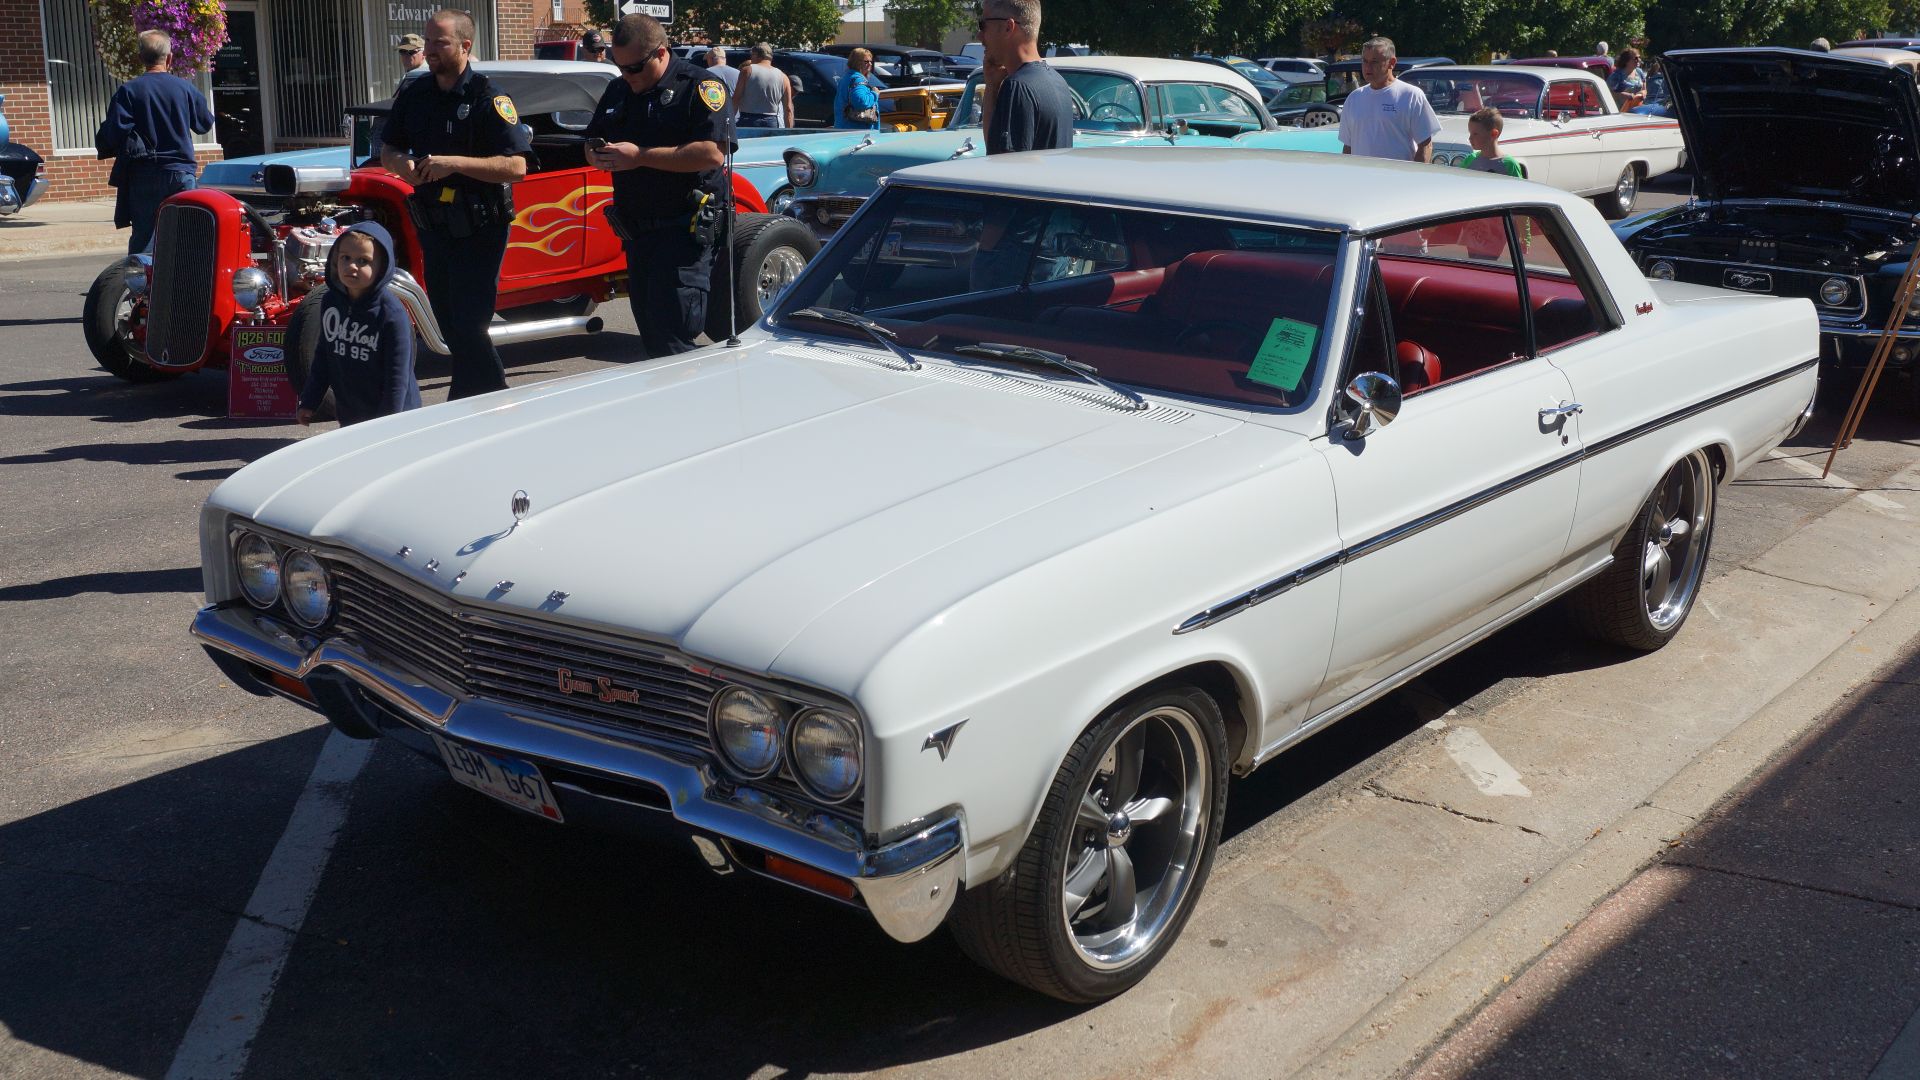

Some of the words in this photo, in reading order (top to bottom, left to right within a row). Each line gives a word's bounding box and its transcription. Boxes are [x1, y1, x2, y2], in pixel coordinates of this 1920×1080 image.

[634, 5, 648, 14] ONE
[652, 6, 667, 16] WAY
[237, 331, 263, 347] 1926
[249, 348, 282, 360] Ford
[558, 667, 593, 694] Gran
[597, 676, 640, 704] Sport
